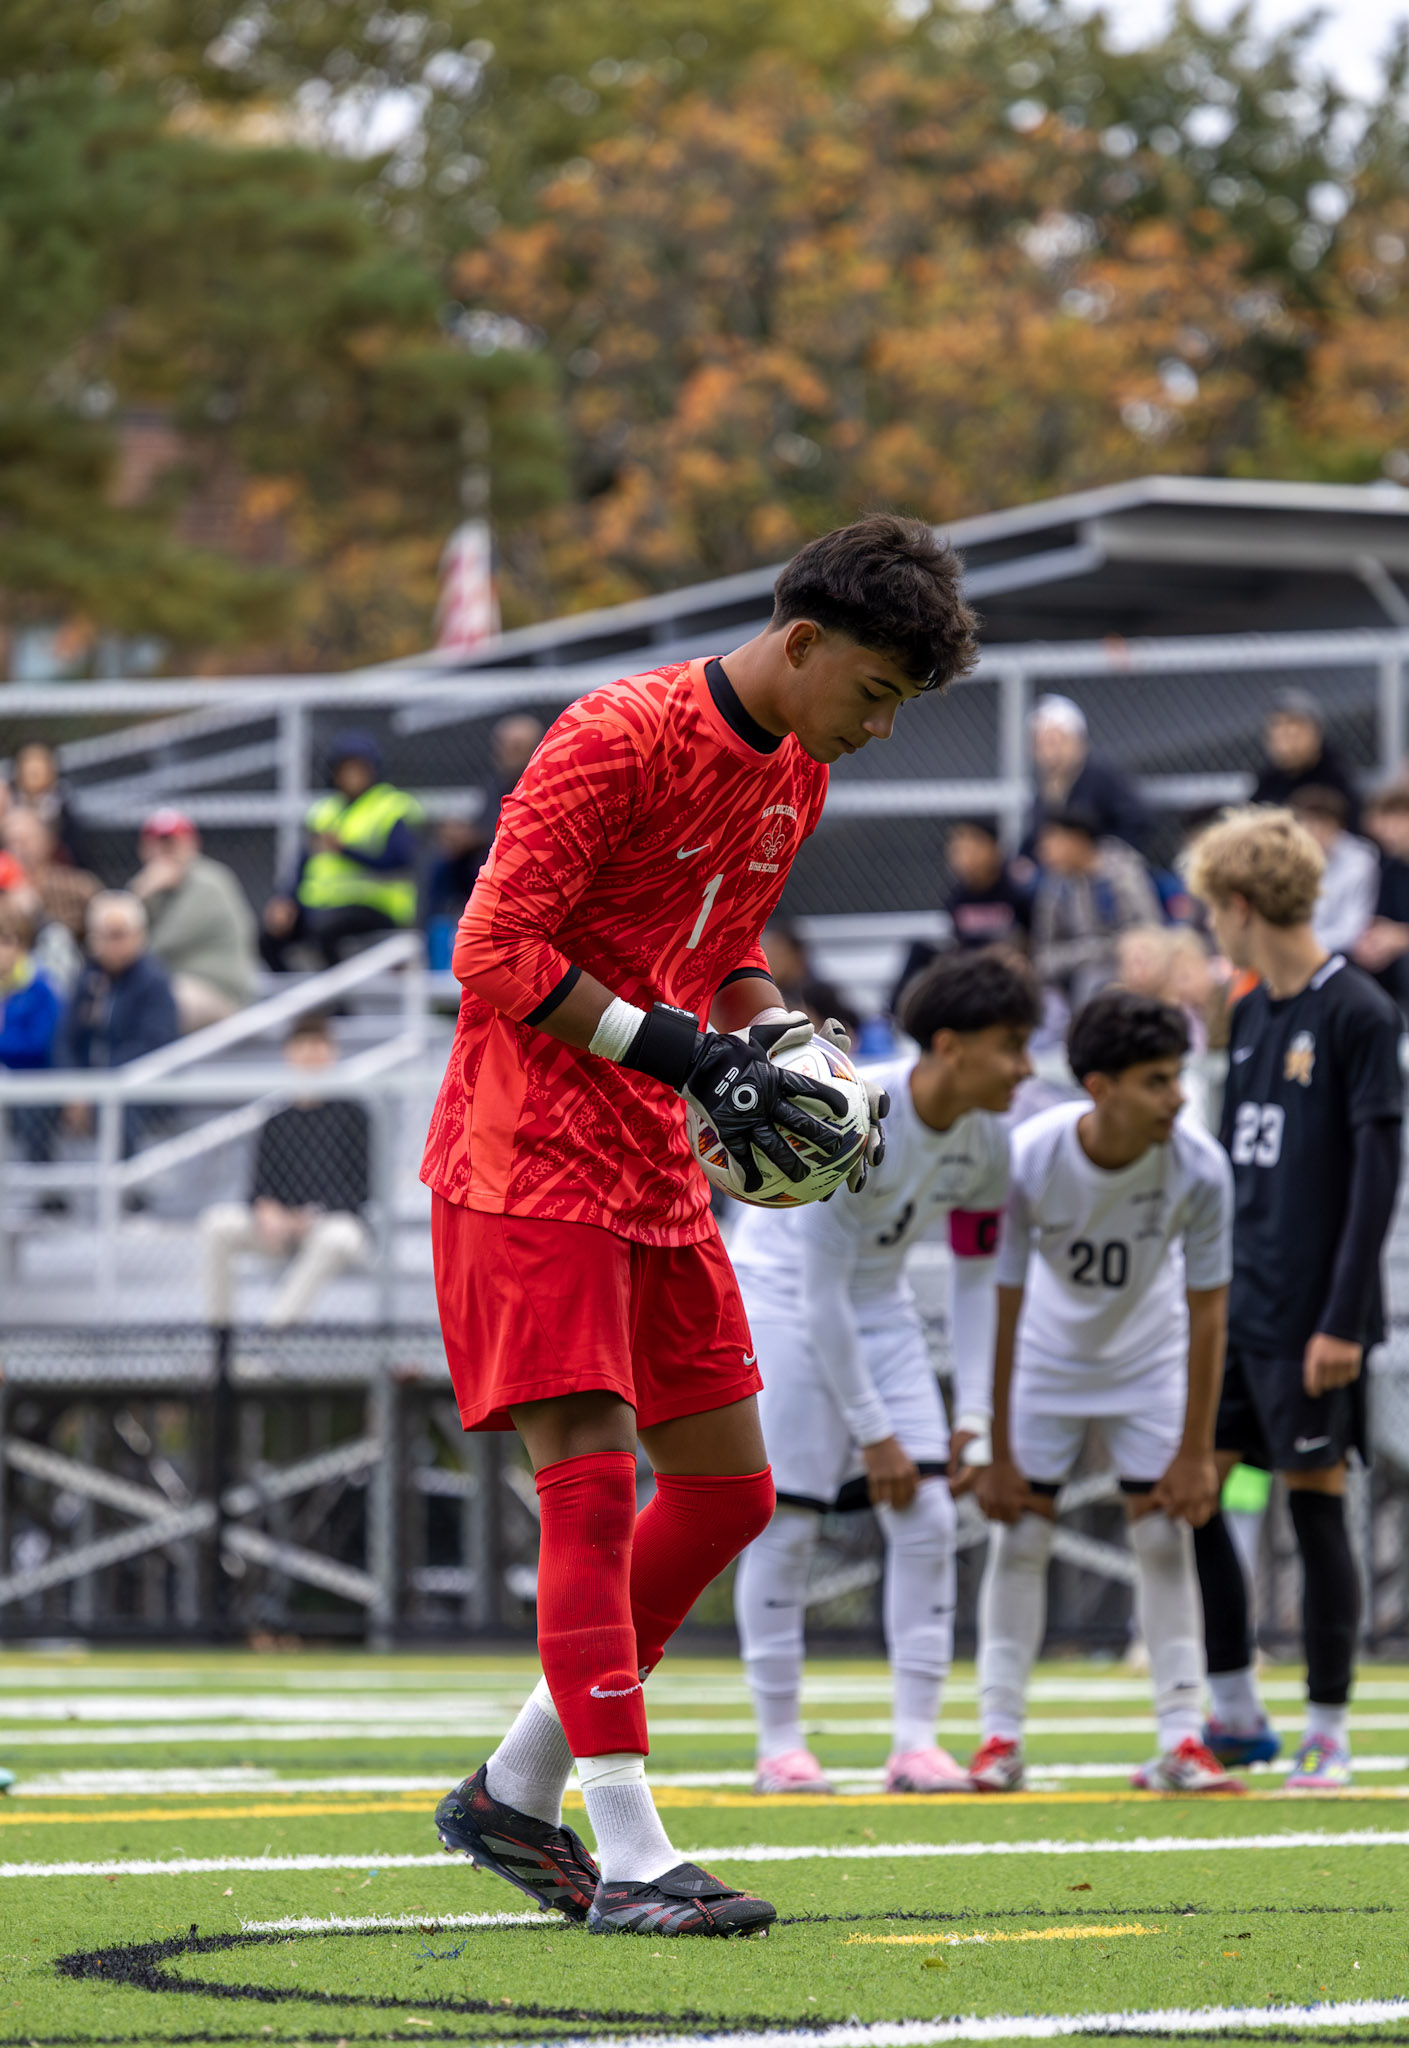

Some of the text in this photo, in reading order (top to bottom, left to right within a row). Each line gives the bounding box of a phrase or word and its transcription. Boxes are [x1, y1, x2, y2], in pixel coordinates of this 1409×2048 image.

[686, 873, 724, 949] 1
[1231, 1101, 1286, 1168] 23
[1069, 1240, 1130, 1289] 20
